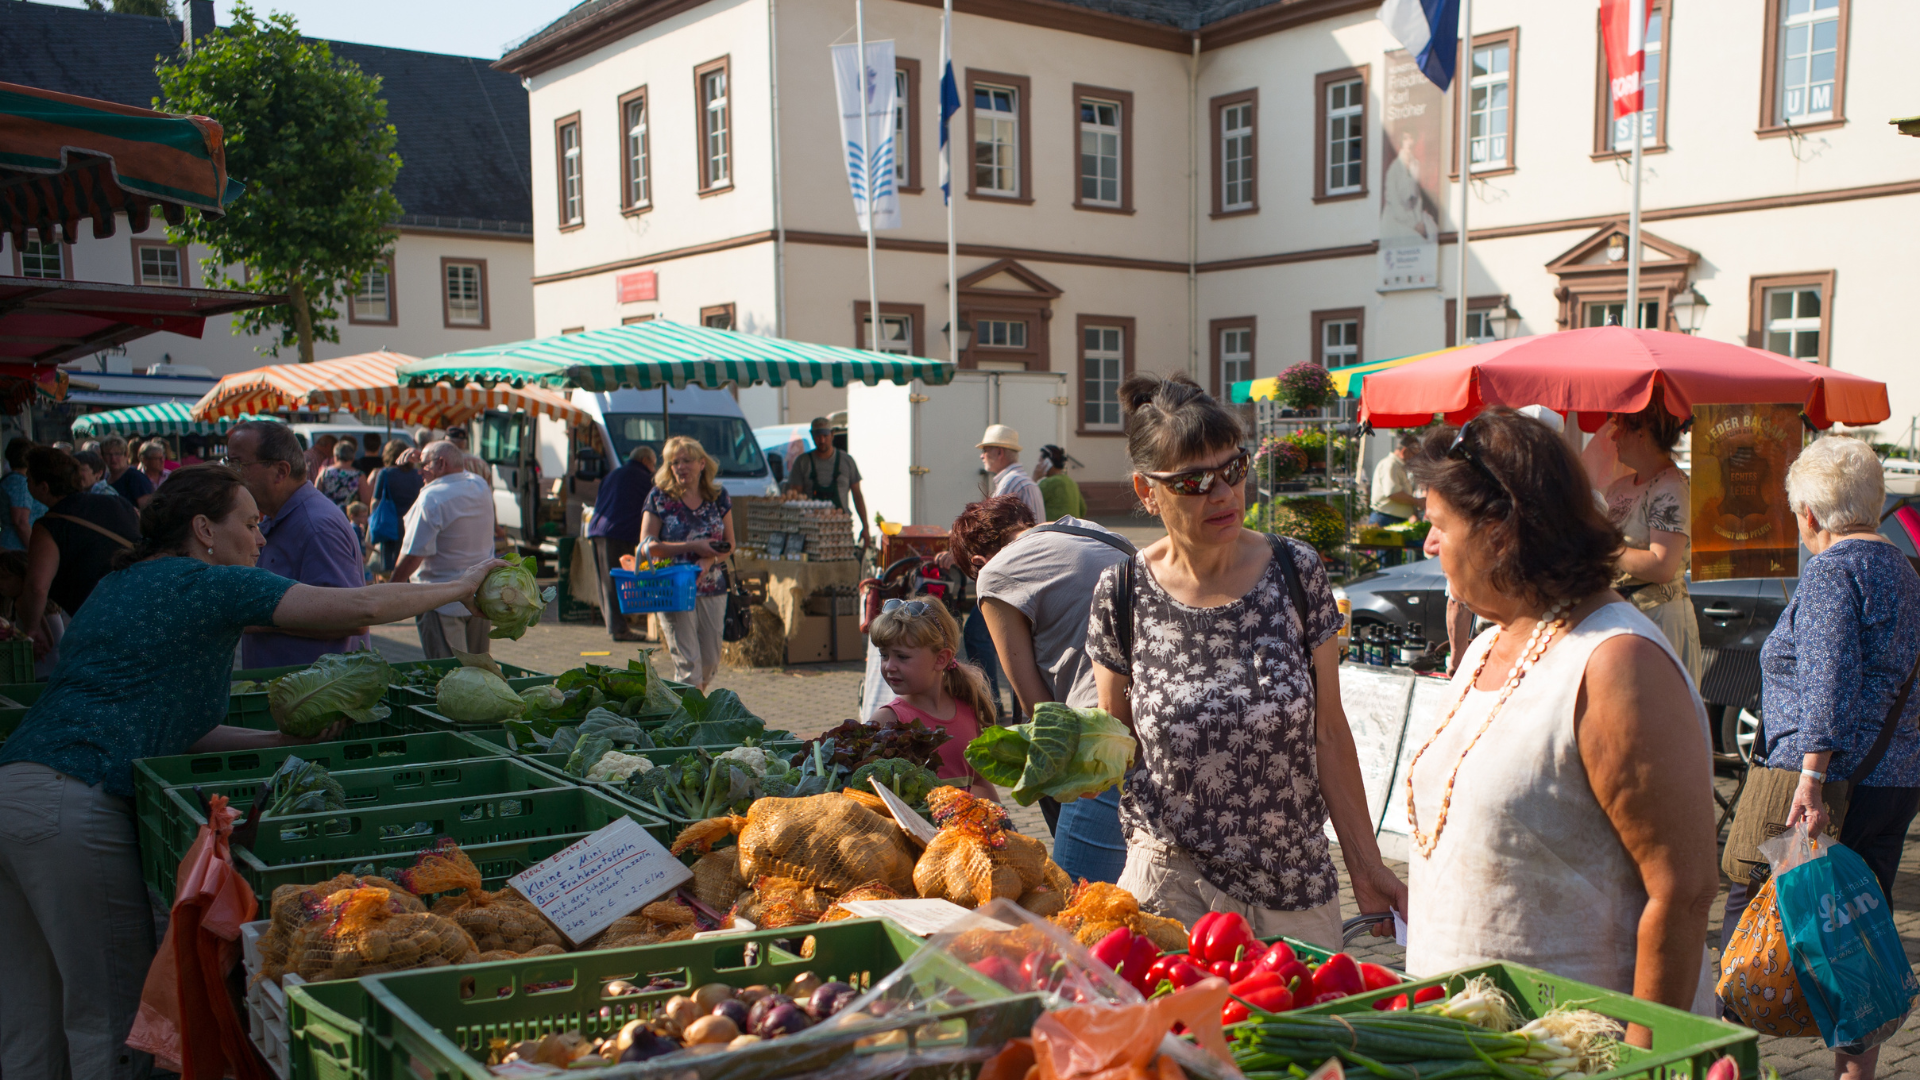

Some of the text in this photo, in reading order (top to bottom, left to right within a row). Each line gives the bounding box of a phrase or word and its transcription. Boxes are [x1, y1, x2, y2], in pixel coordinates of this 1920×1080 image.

[1705, 416, 1740, 444] LEDER
[1743, 415, 1788, 442] BALSAM
[1730, 472, 1757, 482] ECHTES
[1730, 485, 1756, 496] LEDER
[1713, 522, 1772, 541] REINIGT UND PFLEGT
[519, 864, 545, 882] Neue
[524, 871, 562, 896] Kleine
[579, 846, 602, 867] Mini
[550, 901, 567, 916] mit
[571, 893, 584, 904] der
[586, 876, 609, 894] Schale
